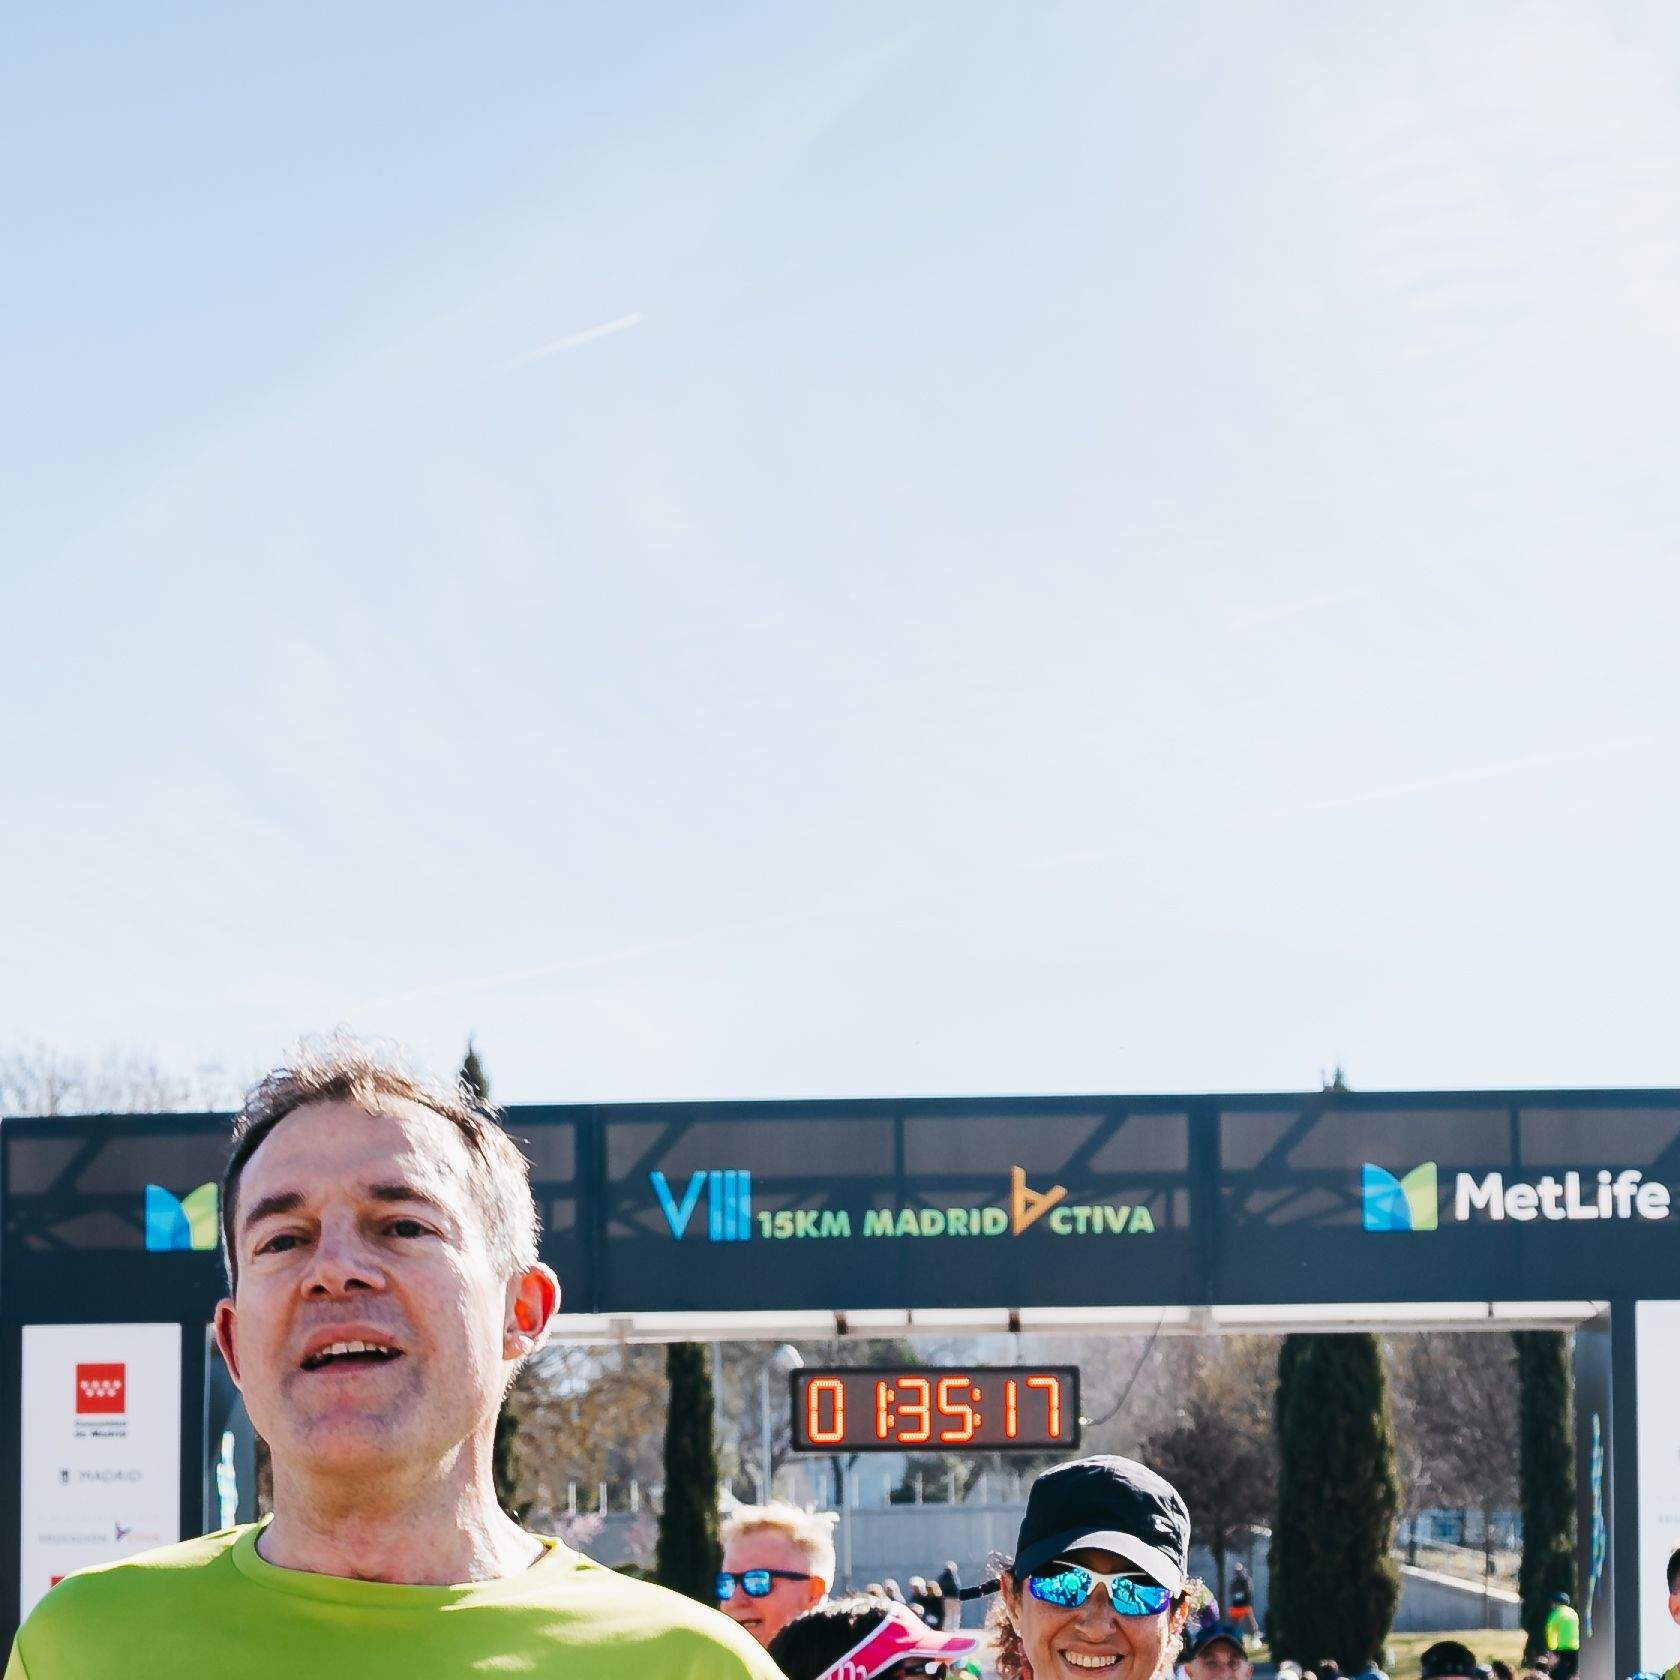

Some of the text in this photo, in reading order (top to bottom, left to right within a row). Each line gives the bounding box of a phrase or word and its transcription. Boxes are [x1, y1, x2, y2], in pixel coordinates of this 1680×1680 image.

[649, 1169, 751, 1242] VIII
[757, 1209, 851, 1239] 15KM
[863, 1208, 1008, 1238] MADRID
[1454, 1169, 1671, 1221] MetLife
